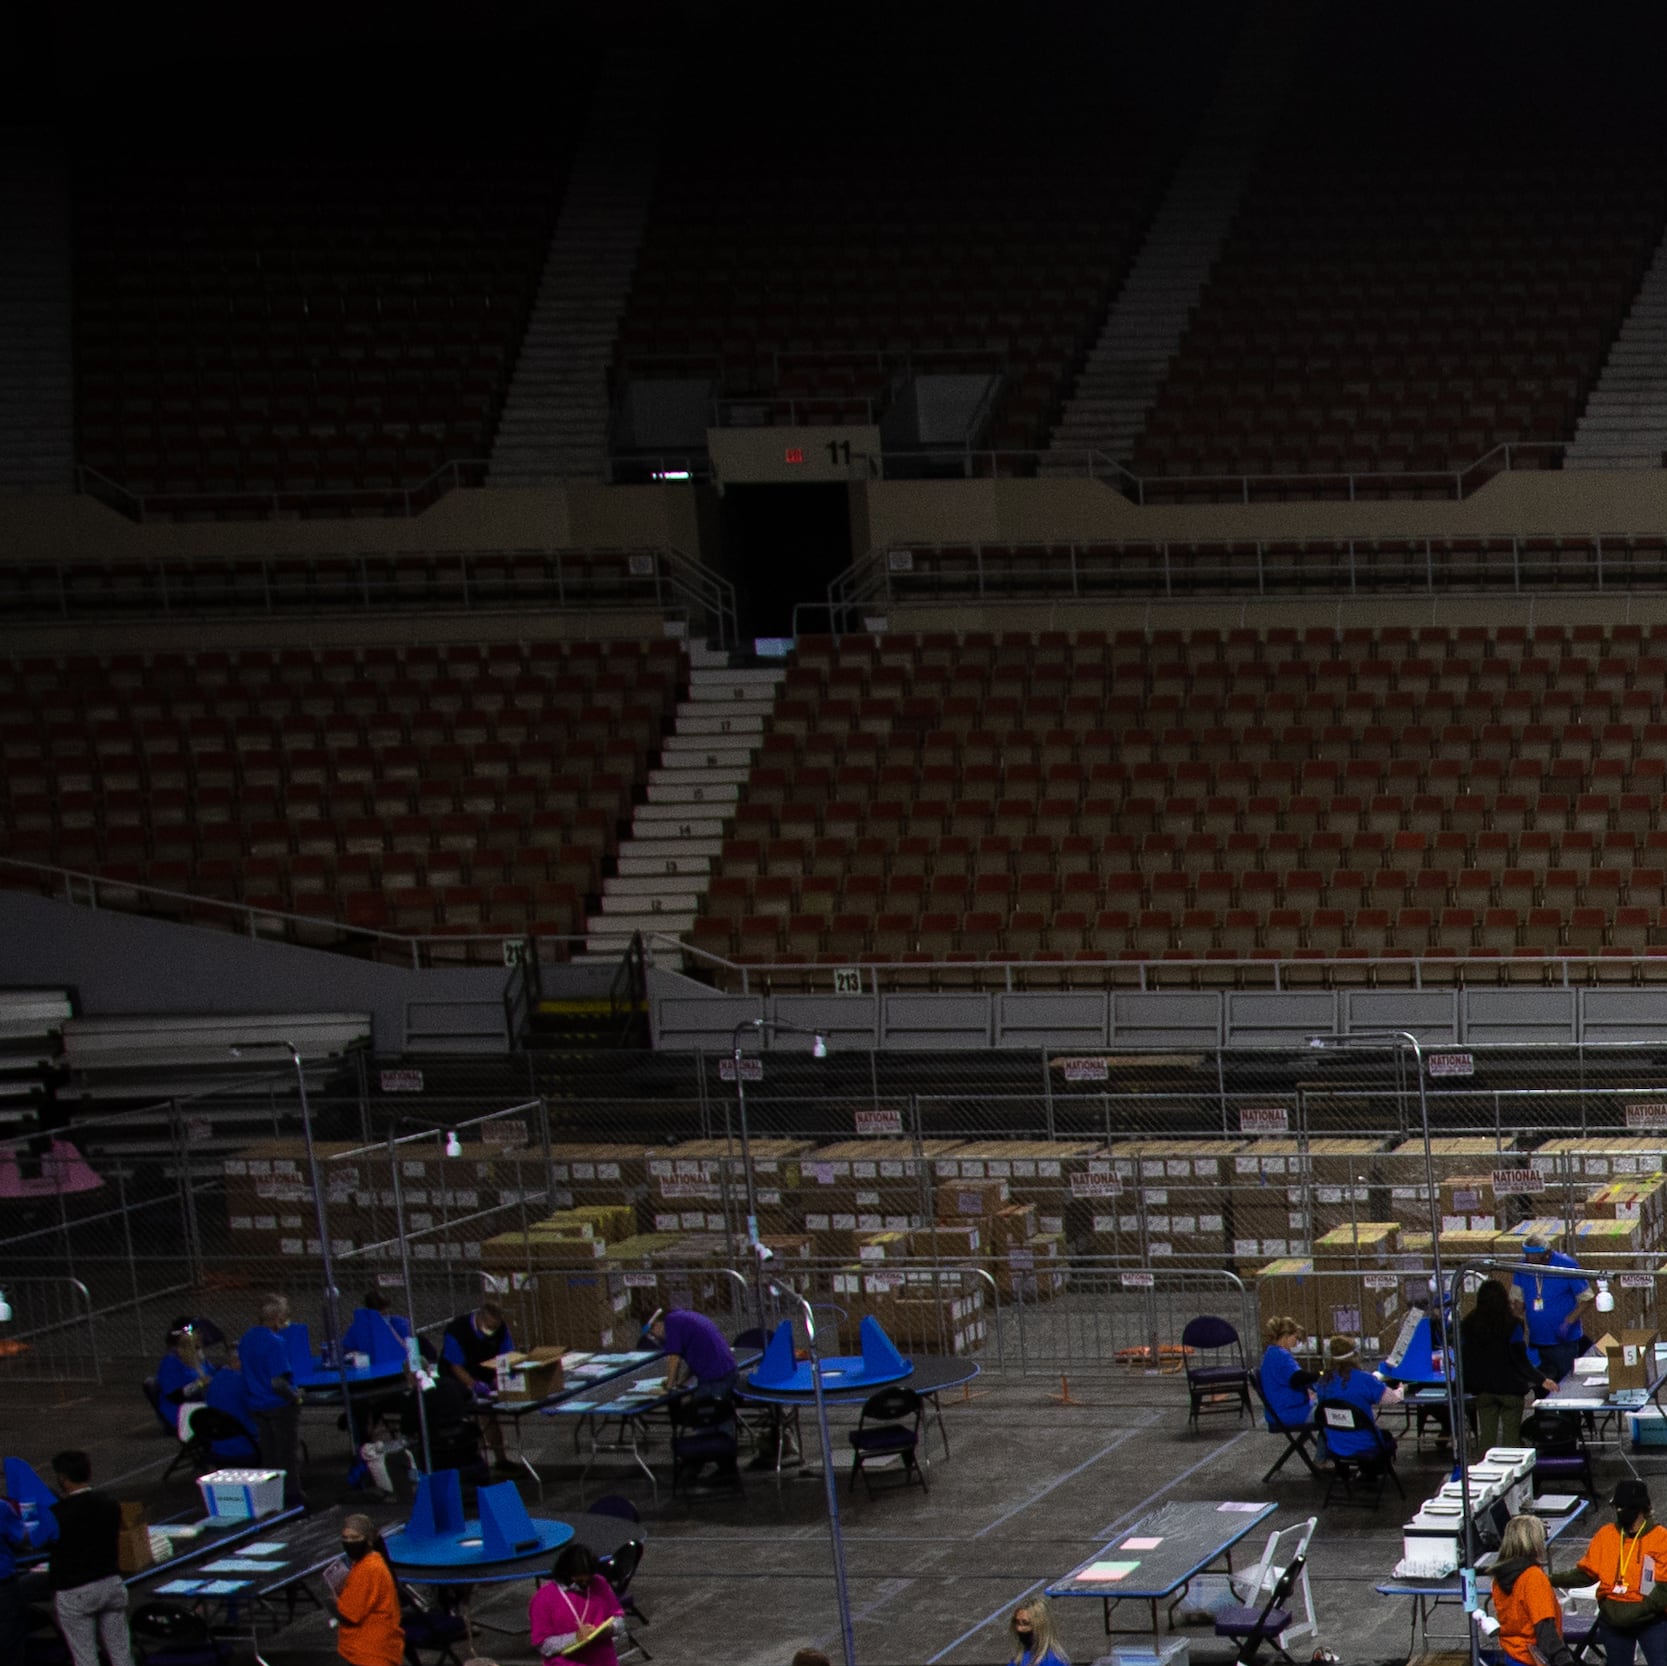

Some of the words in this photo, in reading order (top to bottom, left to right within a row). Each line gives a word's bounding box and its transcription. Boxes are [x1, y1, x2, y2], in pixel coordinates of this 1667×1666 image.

[825, 440, 851, 465] 11
[837, 973, 860, 991] 213
[857, 1111, 900, 1122] NATIONAL
[1242, 1109, 1286, 1120] NATIONAL
[1072, 1173, 1119, 1185] NATIONAL
[1493, 1170, 1543, 1182] NATIONAL
[1627, 1351, 1634, 1362] 5
